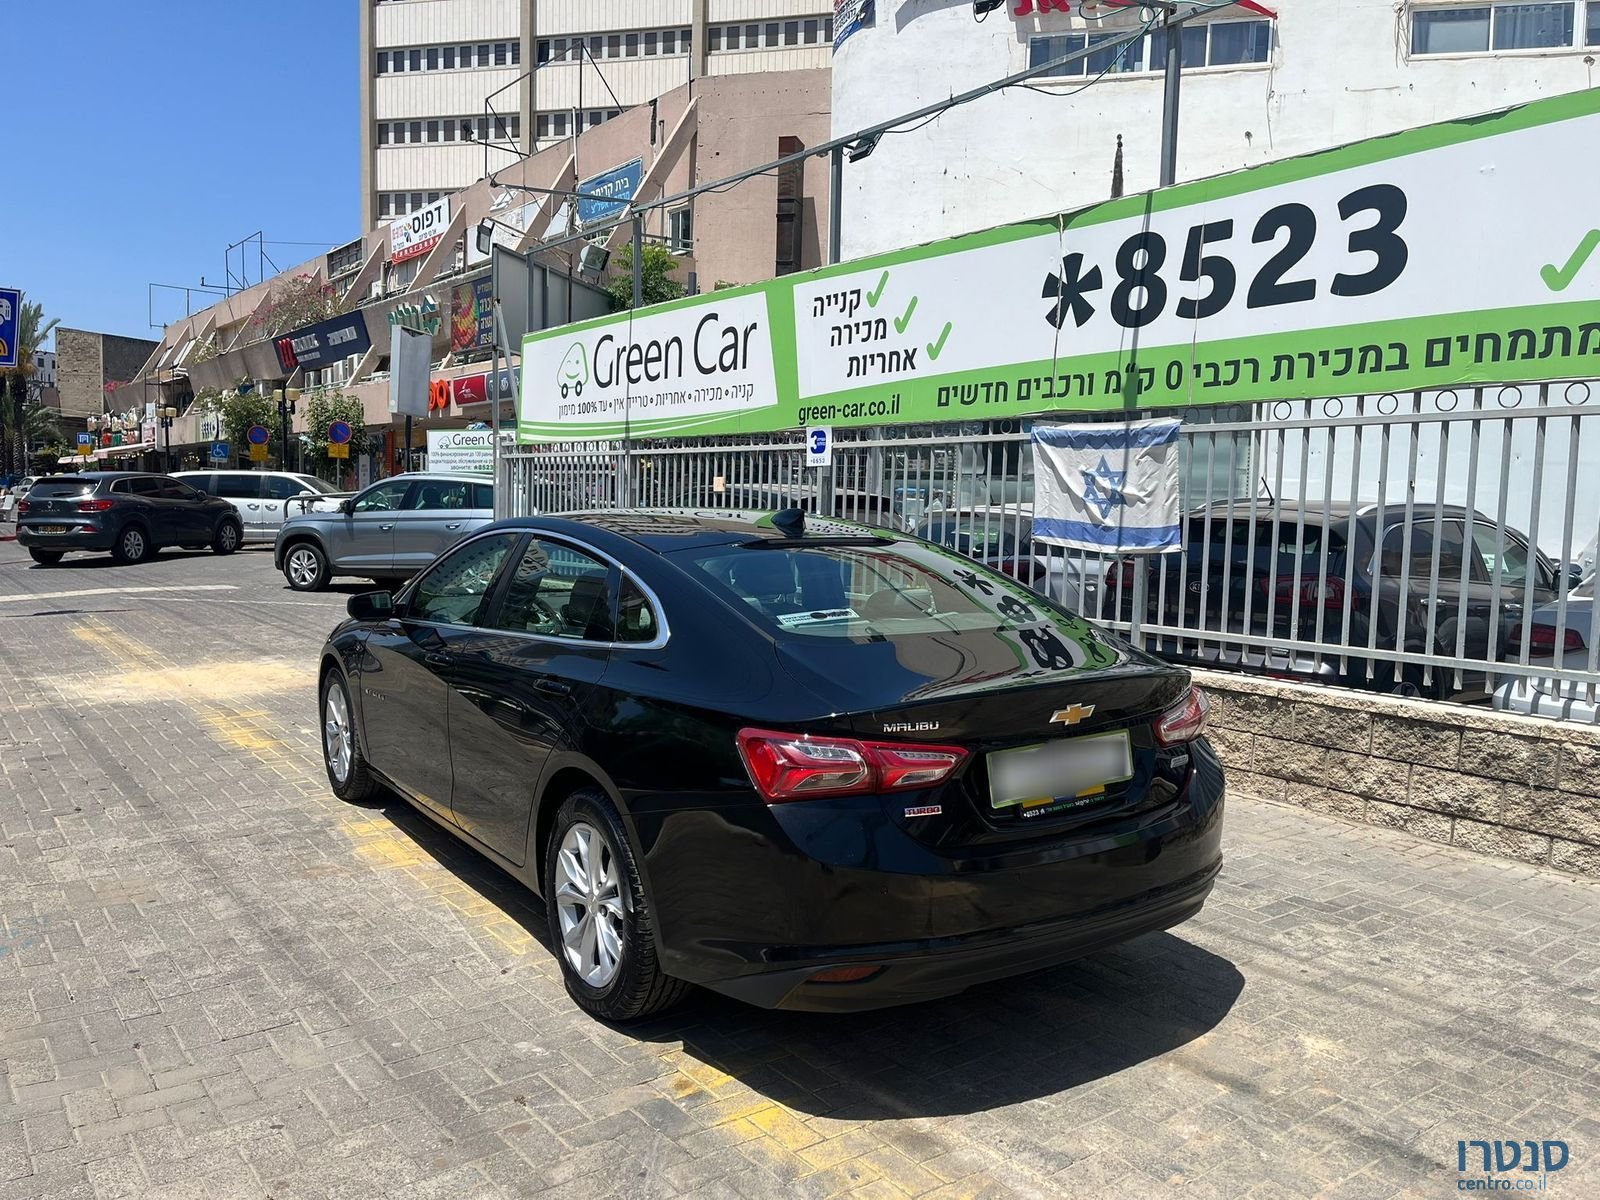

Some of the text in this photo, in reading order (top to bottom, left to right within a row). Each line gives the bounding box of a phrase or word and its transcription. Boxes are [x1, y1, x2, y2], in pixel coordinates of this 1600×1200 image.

[614, 177, 630, 192] בית
[412, 205, 443, 235] דפוס
[813, 288, 861, 318] קנייה
[830, 317, 887, 347] מכירה
[1425, 322, 1600, 368] מתמחים
[593, 312, 757, 389] Green Car
[846, 347, 918, 378] אחריות
[1269, 342, 1410, 382] במכירת
[1165, 360, 1183, 390] 0
[1192, 358, 1260, 387] רכבי
[655, 390, 687, 406] אחריות
[694, 387, 723, 403] מכירה
[731, 383, 754, 402] קניה
[937, 381, 1009, 407] חדשים
[1016, 373, 1094, 401] ורכבים
[558, 402, 576, 420] מימון
[578, 402, 597, 414] 100%
[599, 399, 608, 412] עד
[613, 397, 625, 414] אין
[798, 393, 900, 425] green-car.co.il
[452, 433, 485, 446] Green
[883, 721, 940, 732] MALIBU
[906, 806, 940, 815] TURBO
